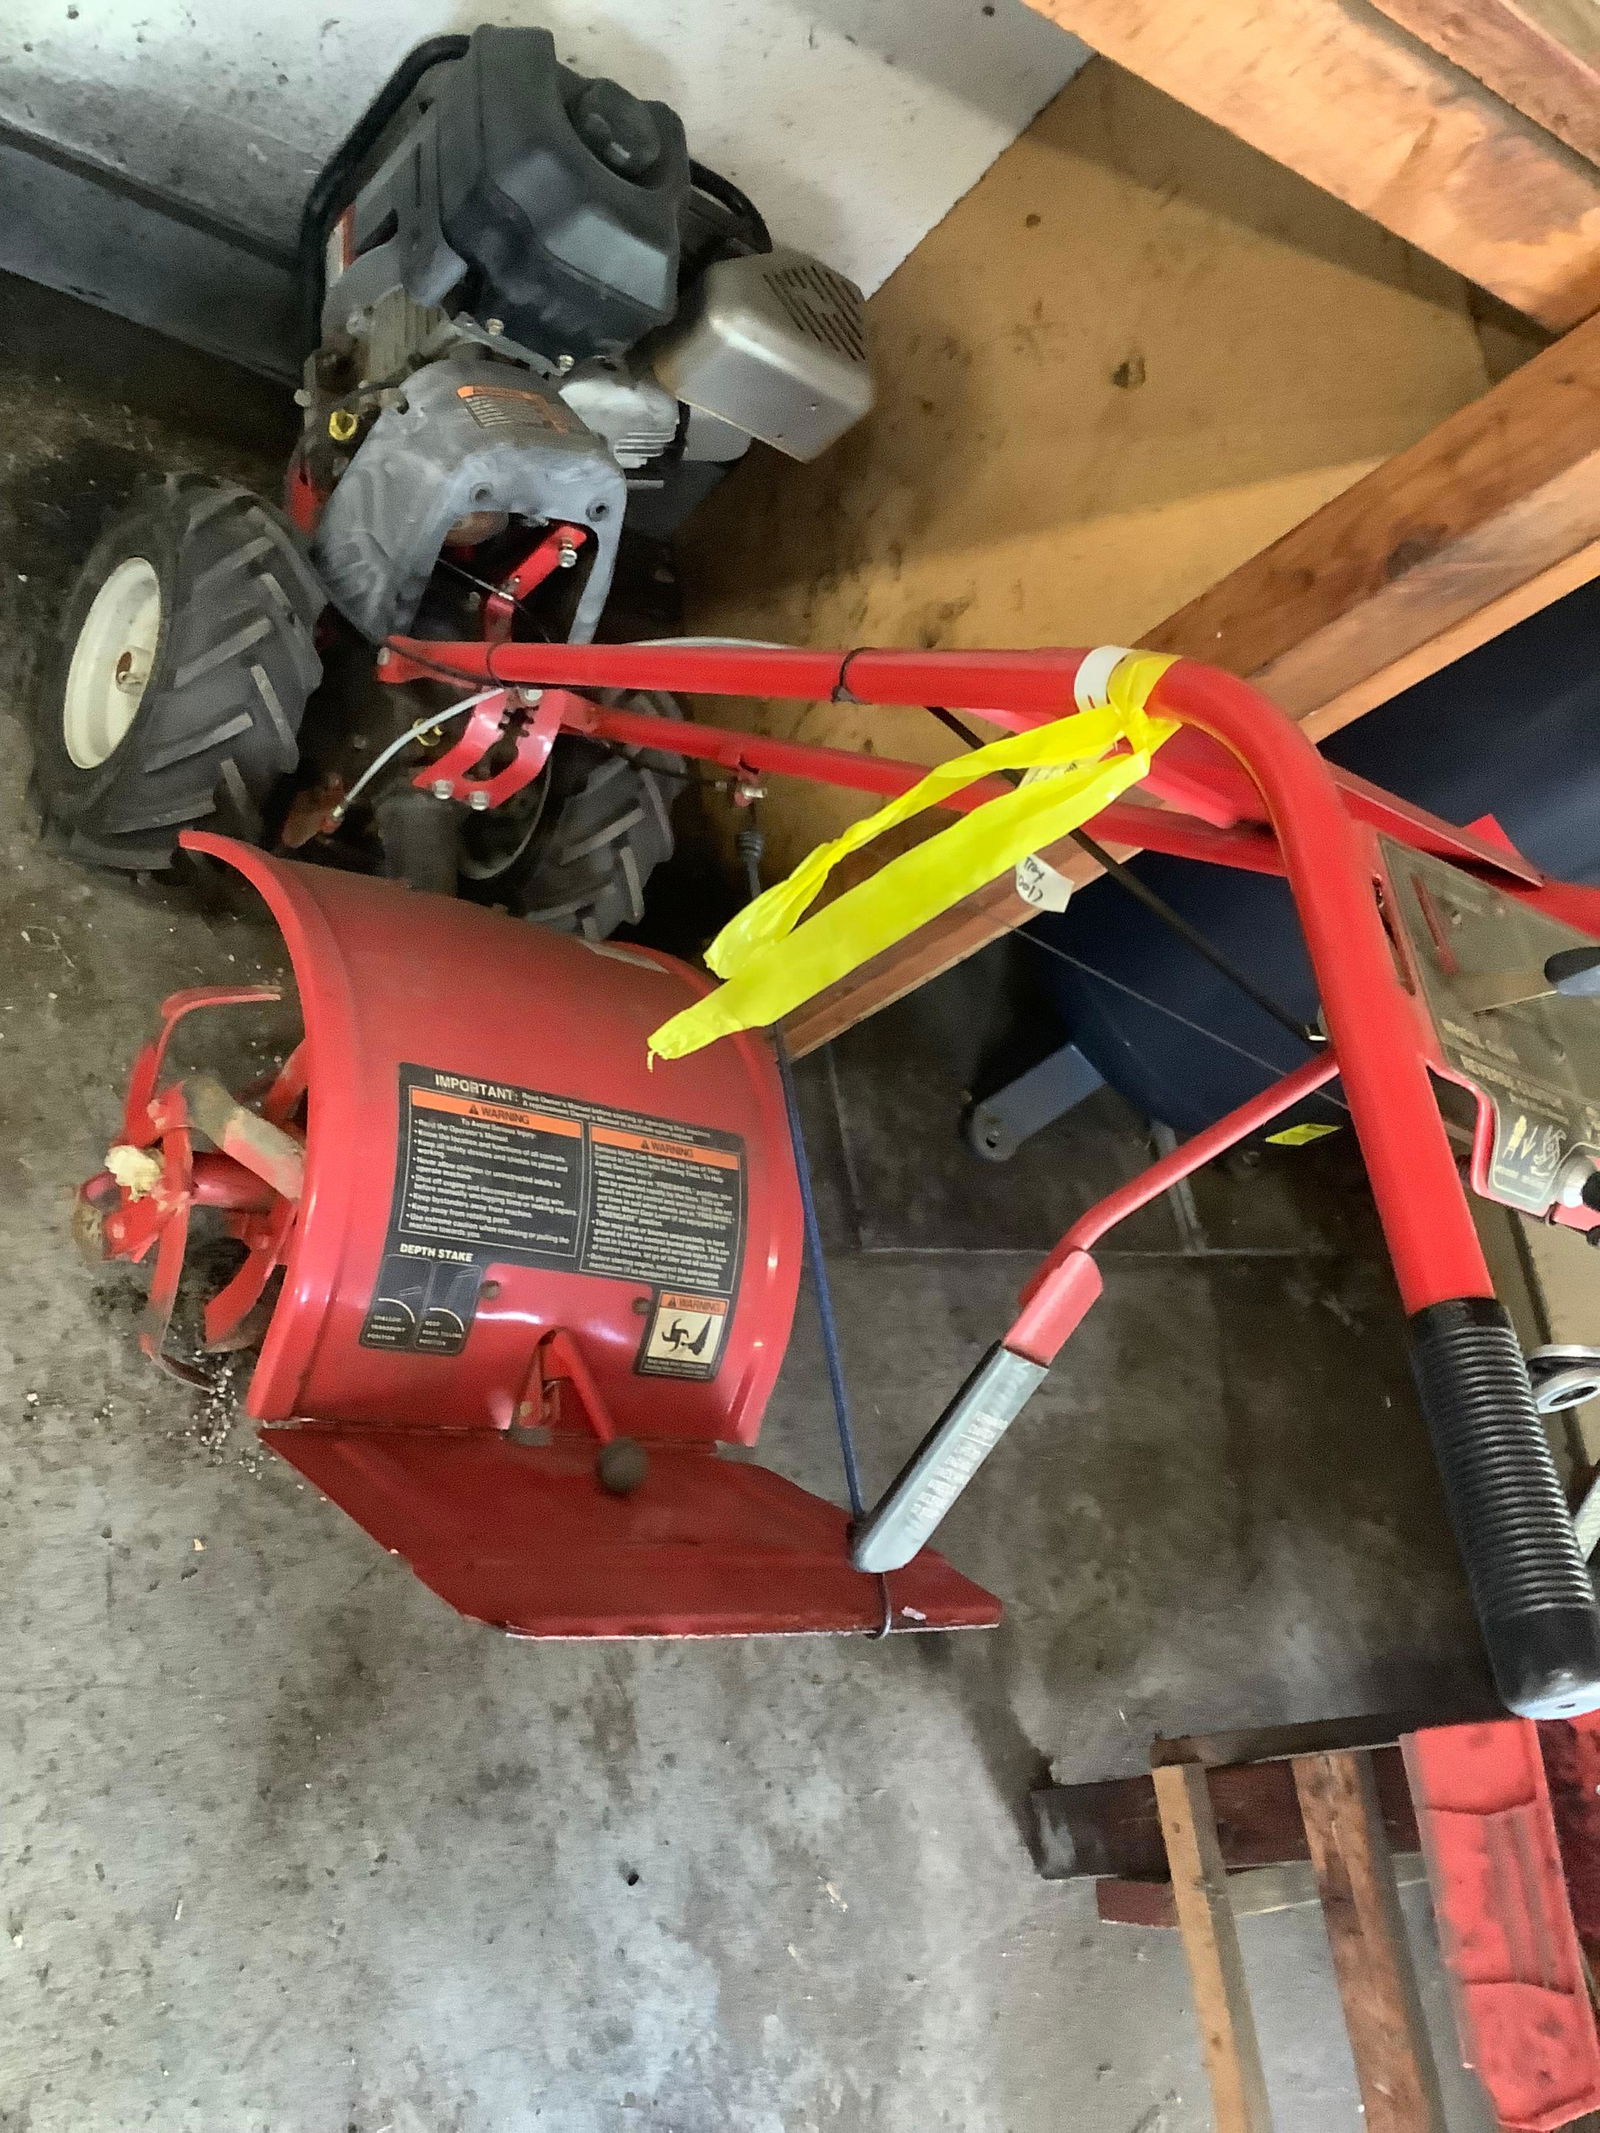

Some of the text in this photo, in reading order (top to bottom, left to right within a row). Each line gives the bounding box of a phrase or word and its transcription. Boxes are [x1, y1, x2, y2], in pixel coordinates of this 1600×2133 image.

[435, 1074, 518, 1102] IMPORTANT:
[481, 1107, 529, 1124] WARNING
[651, 1140, 694, 1158] WARNING
[399, 1243, 474, 1262] DEPTH STAKE
[679, 1298, 721, 1312] WARNING
